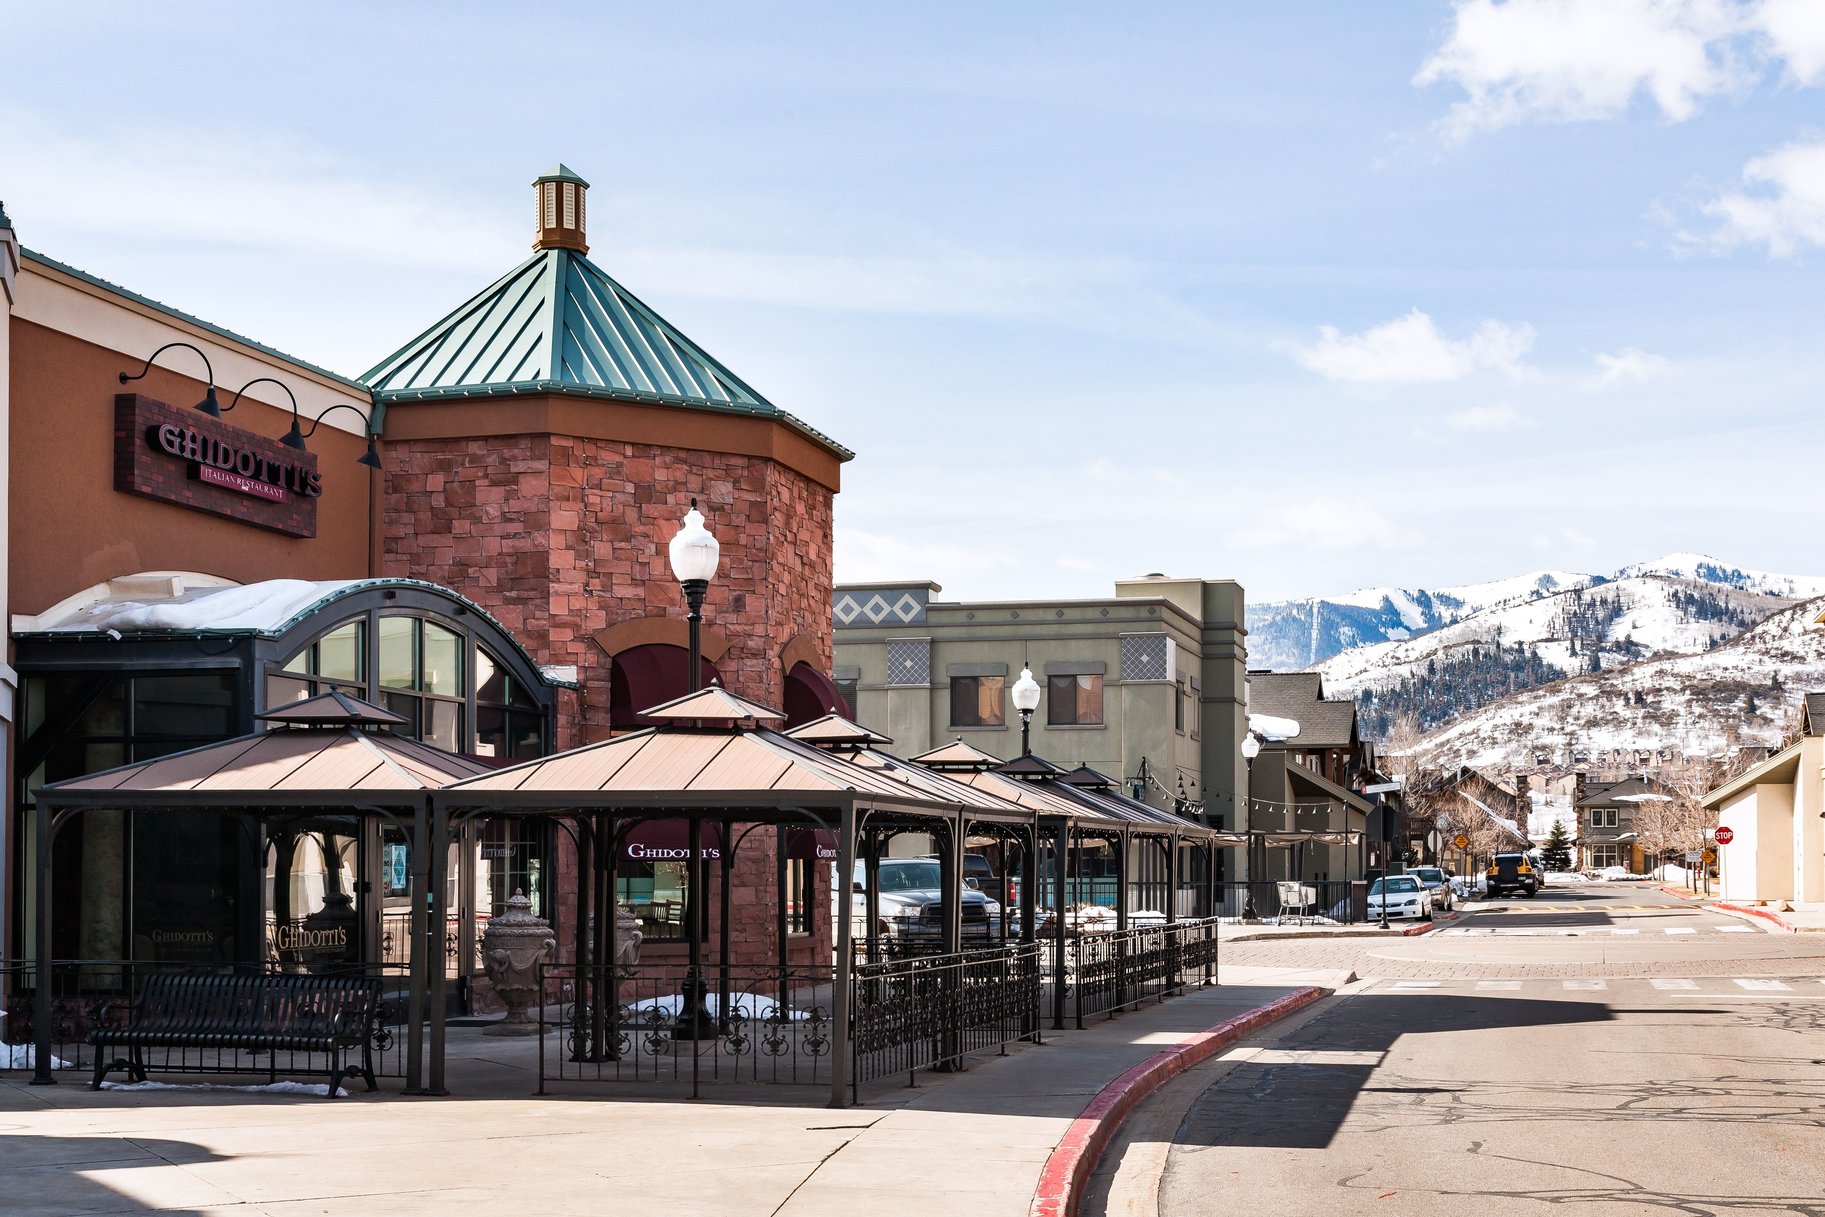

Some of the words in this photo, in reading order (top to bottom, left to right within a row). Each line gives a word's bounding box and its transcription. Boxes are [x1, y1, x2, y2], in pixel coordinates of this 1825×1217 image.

[158, 423, 323, 497] GHIDOTTI'S
[204, 467, 236, 485] ITALIAN
[236, 476, 284, 499] RESTAURANT
[1715, 831, 1733, 840] STOP
[627, 843, 720, 858] GHIDOTI'S
